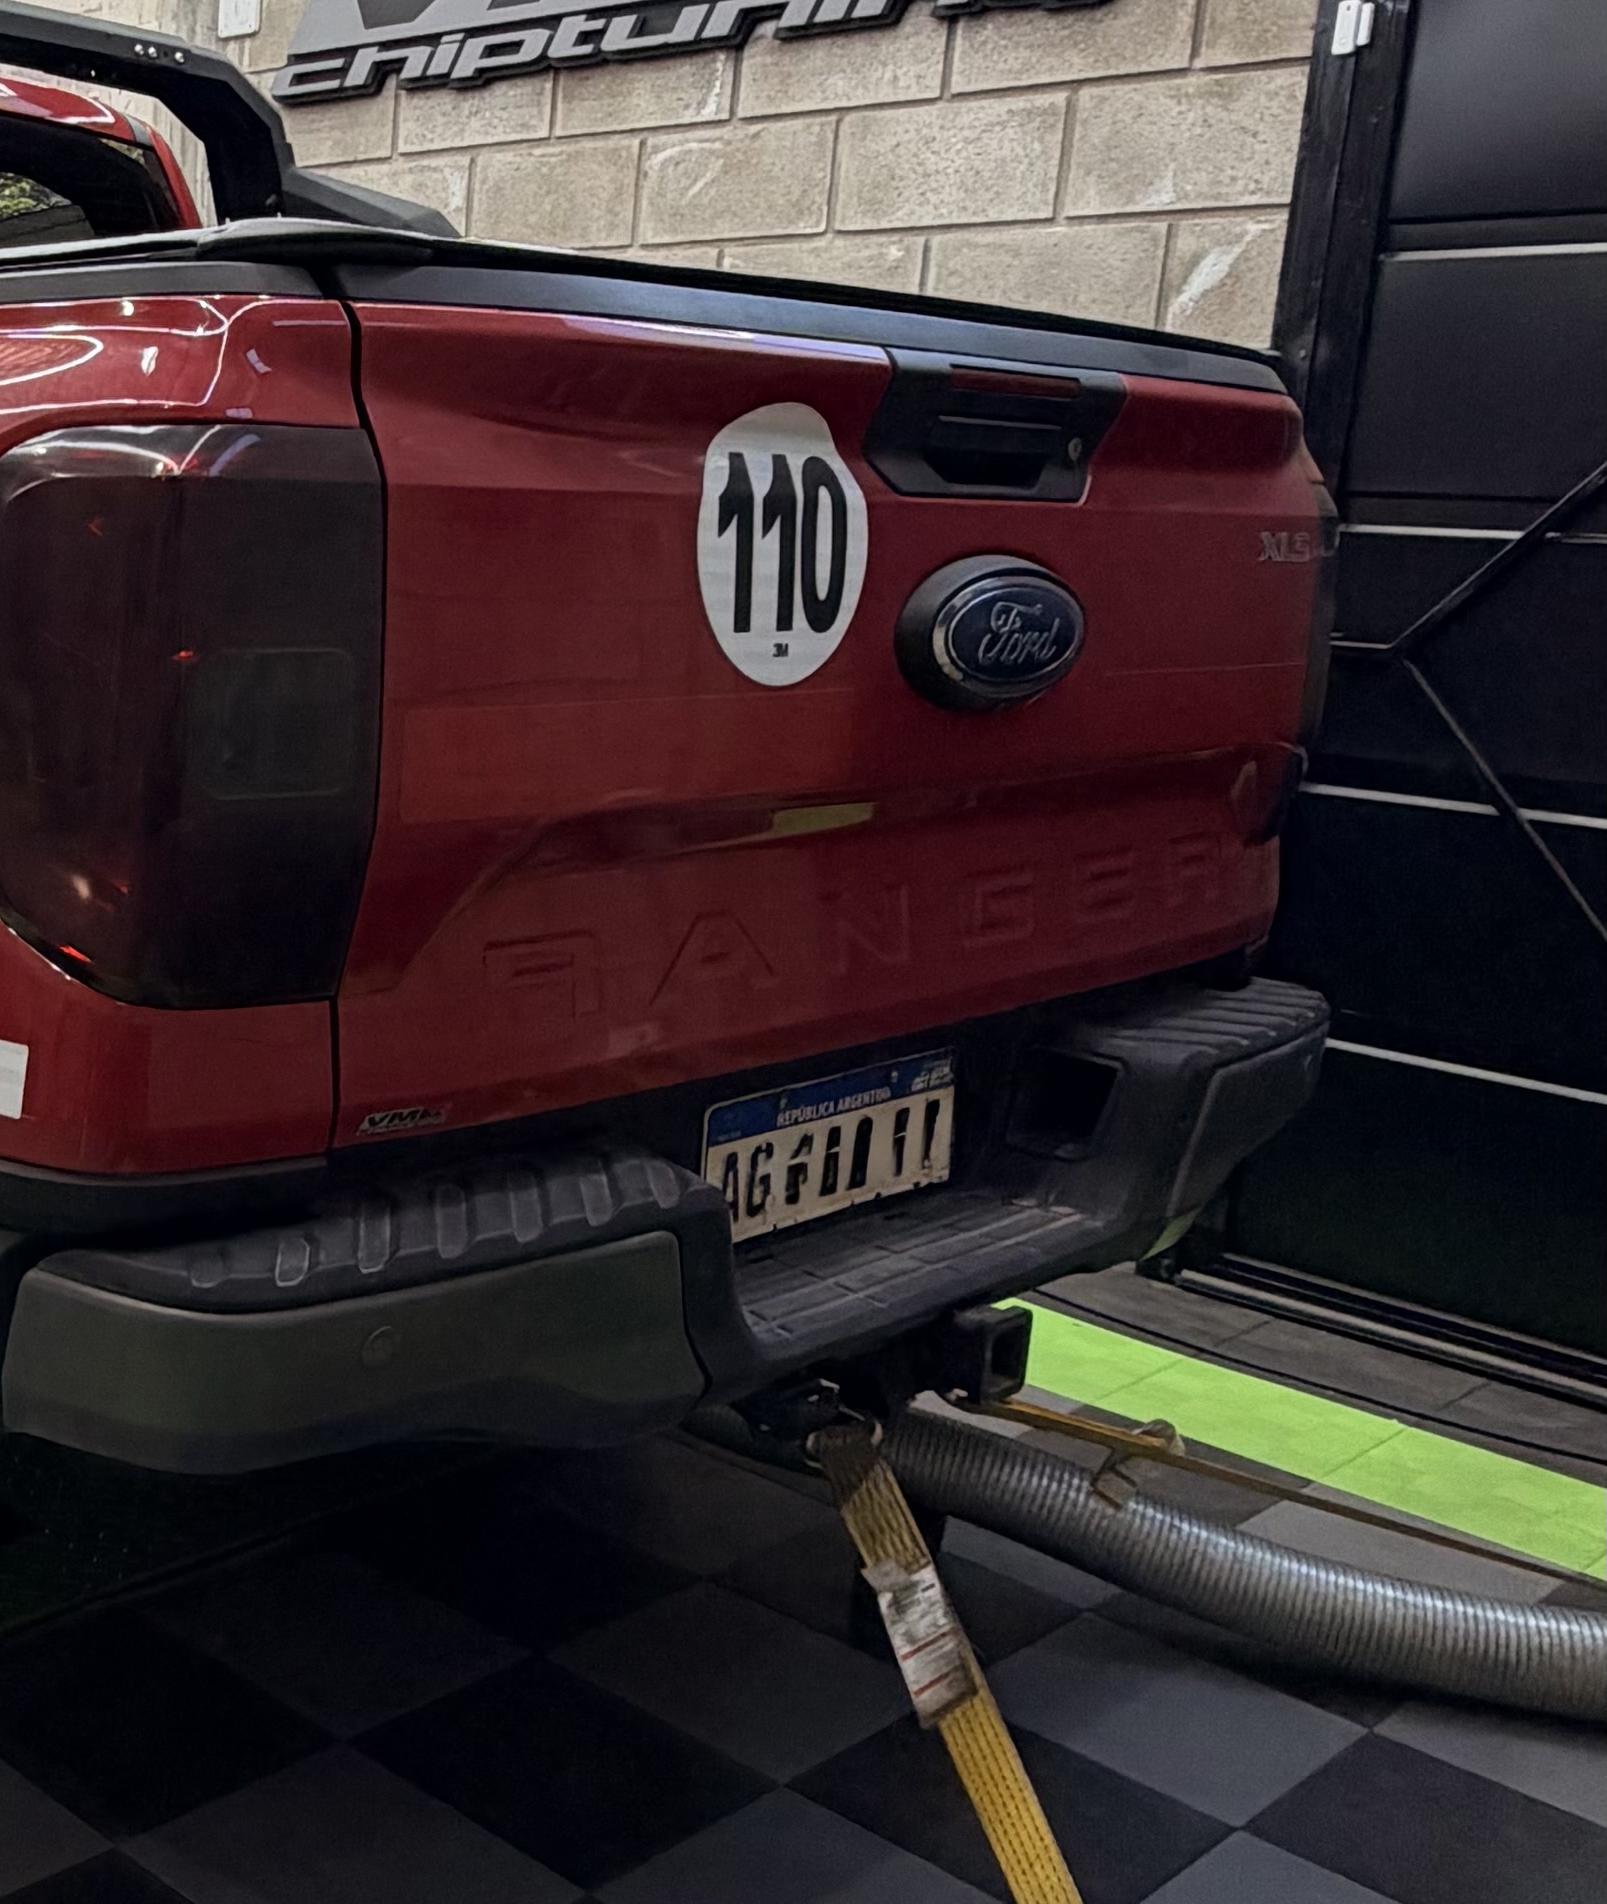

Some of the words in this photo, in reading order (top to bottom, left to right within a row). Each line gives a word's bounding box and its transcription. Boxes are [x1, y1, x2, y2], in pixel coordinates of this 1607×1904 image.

[716, 451, 848, 634] 110
[978, 601, 1060, 665] Ford
[482, 831, 1222, 1020] RANGER
